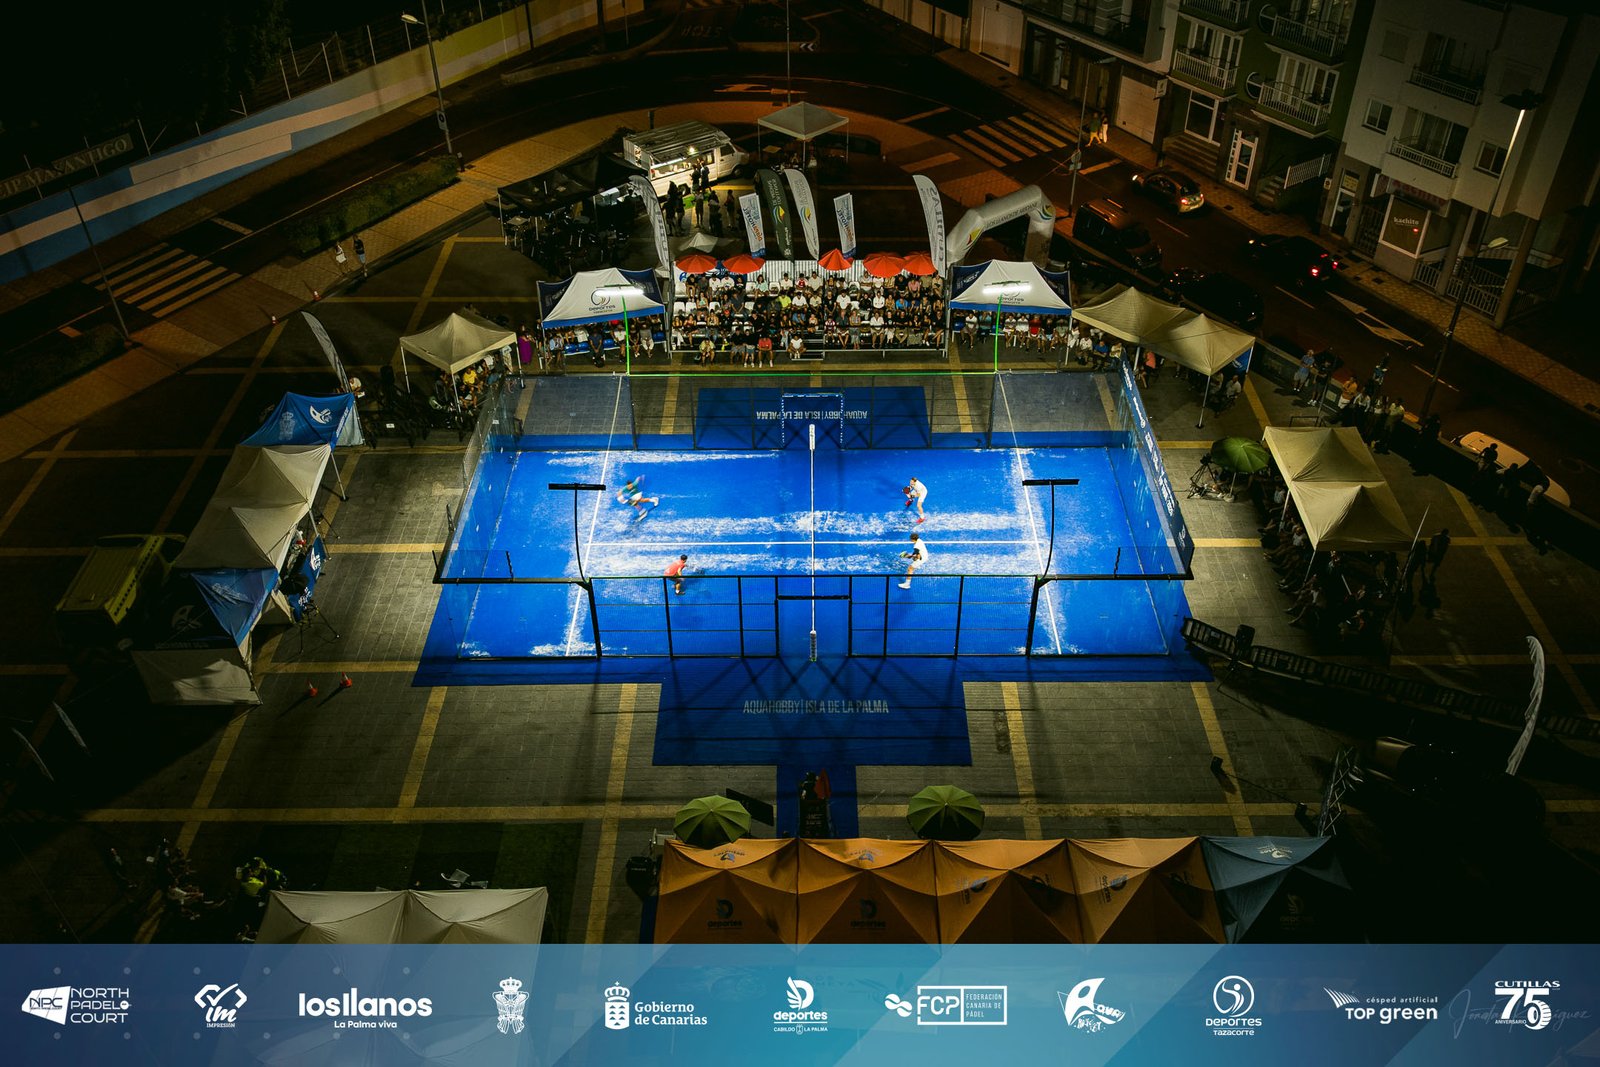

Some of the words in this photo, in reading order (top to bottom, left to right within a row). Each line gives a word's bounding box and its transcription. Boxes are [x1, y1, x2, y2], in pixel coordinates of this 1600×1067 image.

[757, 411, 781, 420] PALMA
[793, 411, 803, 420] DE
[804, 411, 821, 420] ISLA
[743, 699, 800, 714] AQUAHOBBY
[805, 700, 826, 713] ISLA
[828, 700, 840, 713] DE
[842, 700, 854, 713] LA
[856, 699, 889, 714] PALMA
